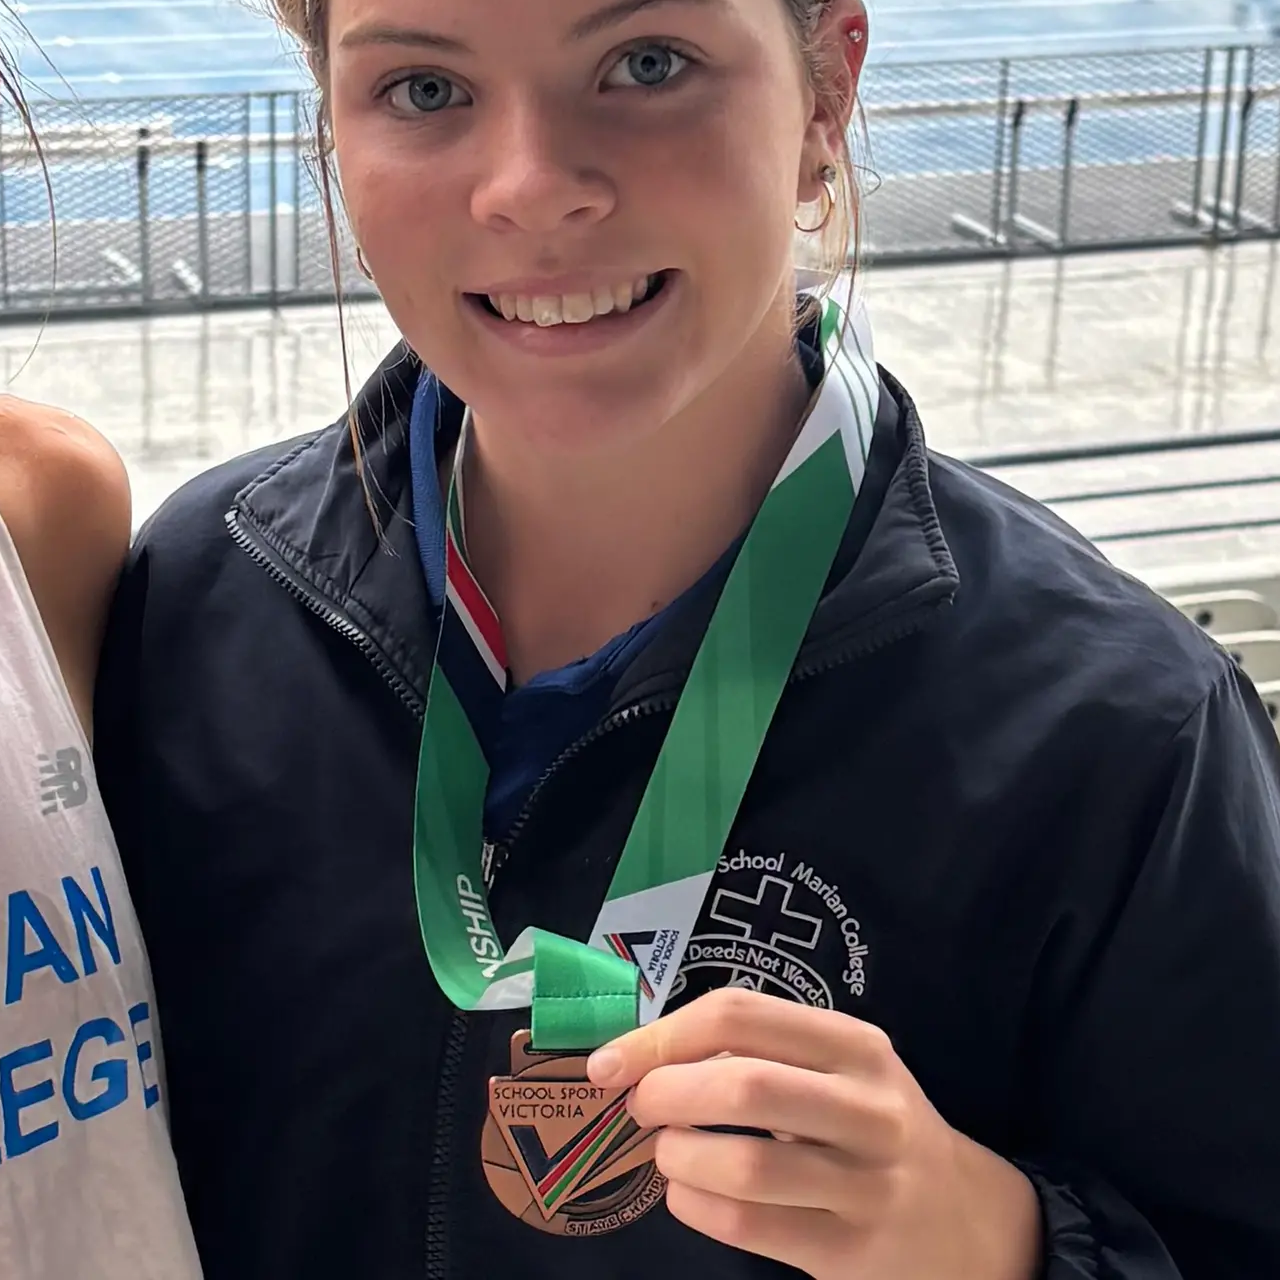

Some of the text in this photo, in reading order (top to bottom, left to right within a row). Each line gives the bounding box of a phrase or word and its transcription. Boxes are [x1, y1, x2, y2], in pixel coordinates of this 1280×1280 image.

[718, 849, 868, 997] School Marian College
[647, 929, 670, 971] VICTORIA
[689, 942, 745, 961] Deeds
[745, 948, 781, 972] Not
[494, 1087, 607, 1100] SCHOOL SPORT
[498, 1103, 585, 1119] VICTORIA
[567, 1215, 619, 1235] STATE
